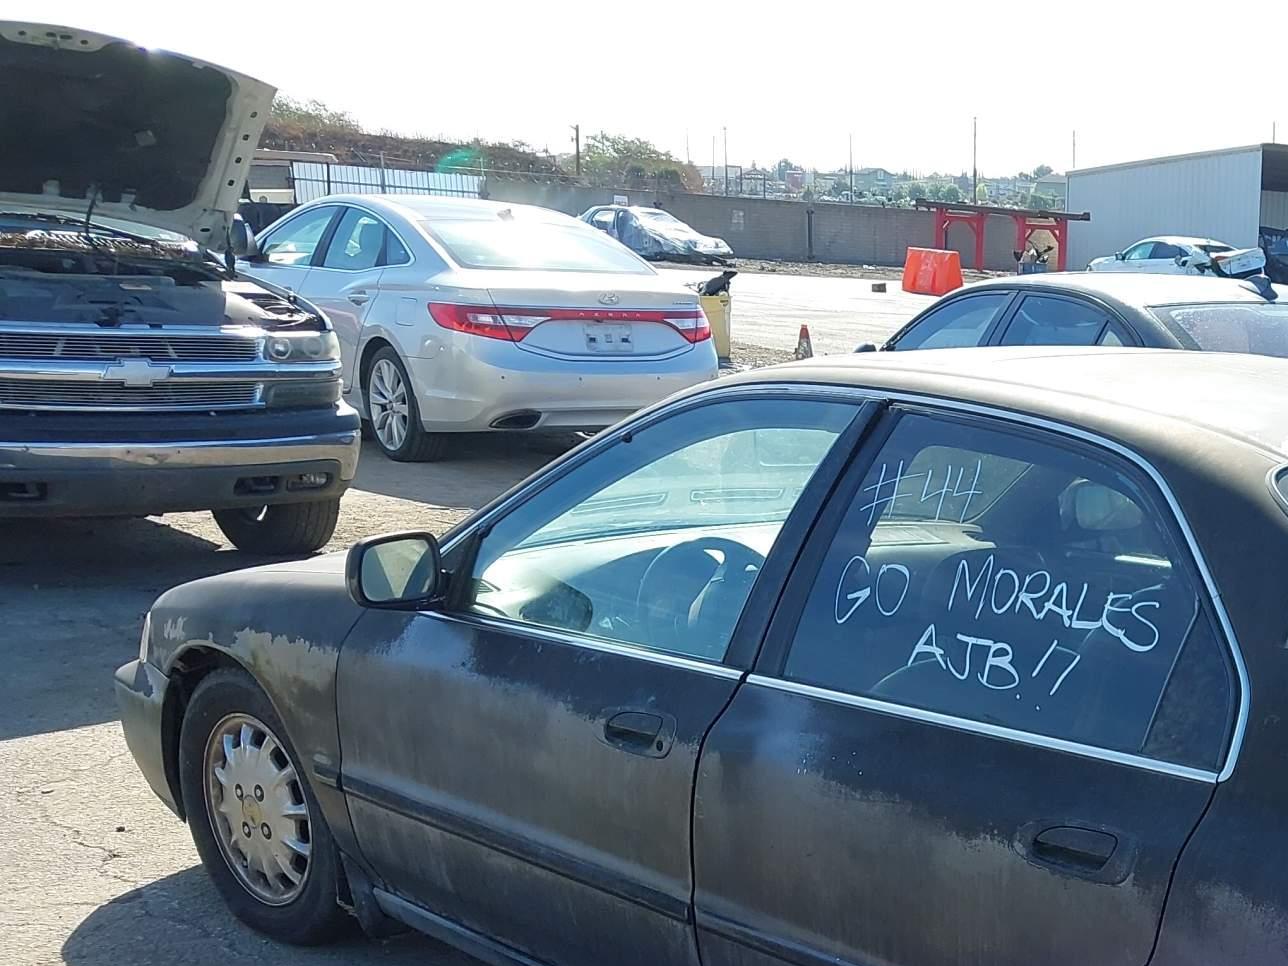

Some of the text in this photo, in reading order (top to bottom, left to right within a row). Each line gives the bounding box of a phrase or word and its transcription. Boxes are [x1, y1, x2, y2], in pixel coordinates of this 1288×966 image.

[859, 458, 983, 526] #44
[834, 553, 1161, 653] GO MORALES
